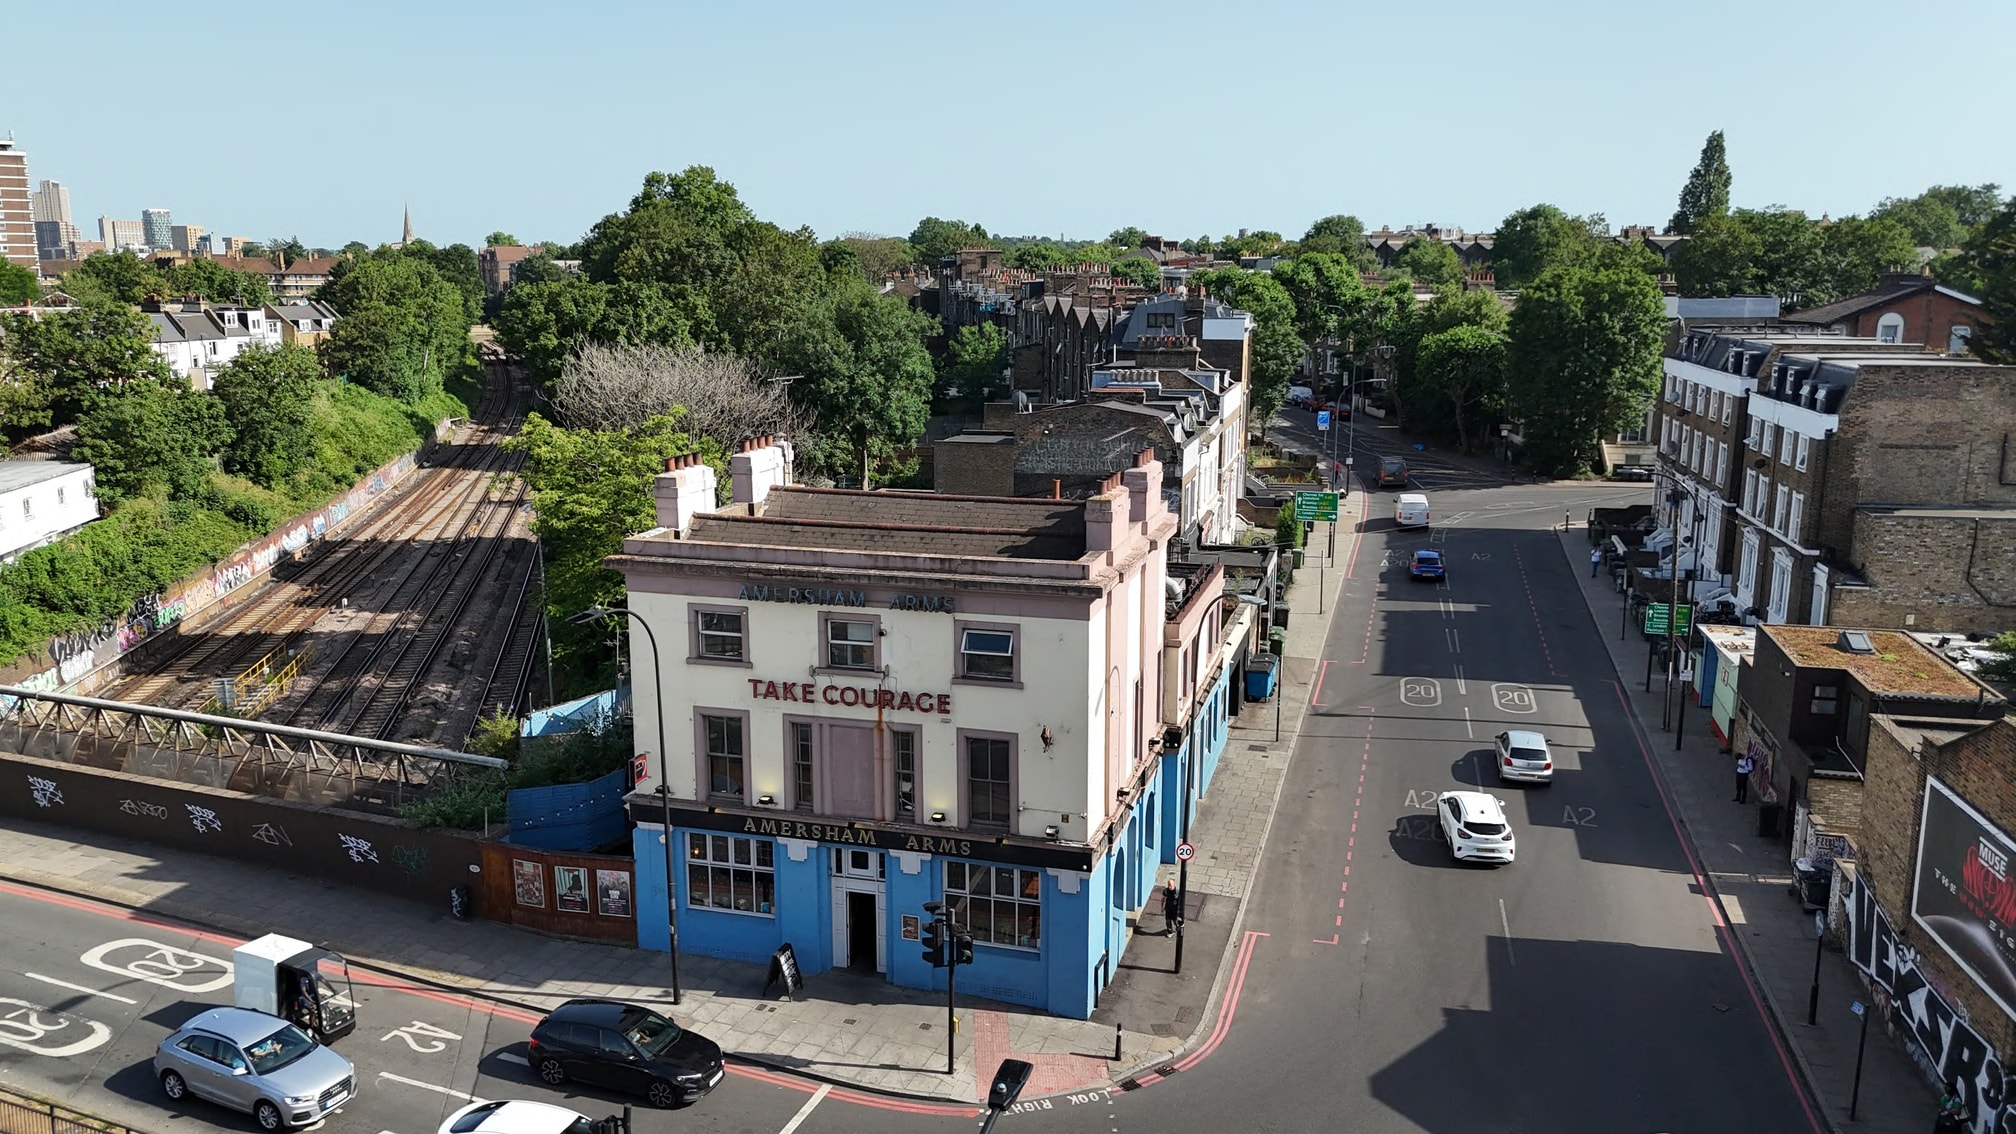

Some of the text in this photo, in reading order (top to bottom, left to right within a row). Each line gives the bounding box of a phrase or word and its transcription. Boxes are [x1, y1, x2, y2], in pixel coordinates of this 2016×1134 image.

[737, 584, 955, 614] AMERSHAM ARMS
[748, 678, 950, 715] TAKE COURAGE
[1406, 684, 1435, 698] 20
[1498, 690, 1529, 705] 20
[1404, 789, 1438, 810] A2
[1562, 805, 1598, 827] A2
[743, 816, 971, 856] AMERSHAM ARMS
[1179, 848, 1192, 856] 20
[1978, 842, 2007, 877] MUSE
[1934, 867, 1956, 895] THE
[127, 949, 204, 979] 20
[380, 1020, 463, 1053] A2
[1066, 1089, 1111, 1106] LOOK
